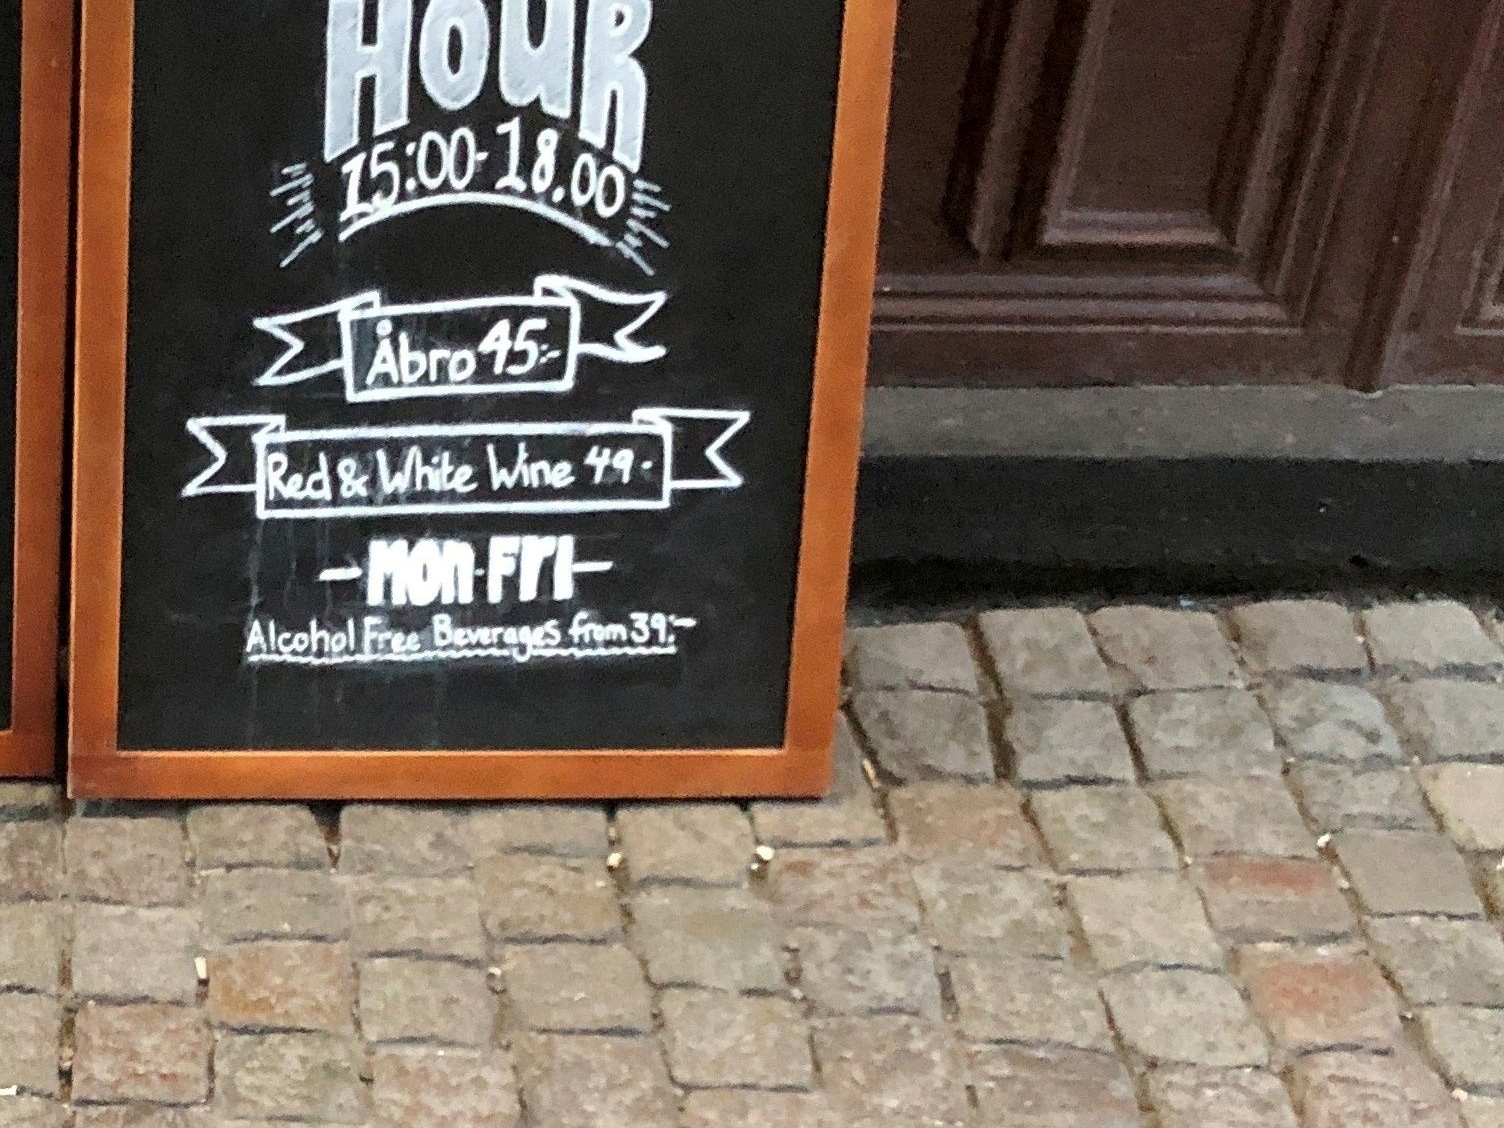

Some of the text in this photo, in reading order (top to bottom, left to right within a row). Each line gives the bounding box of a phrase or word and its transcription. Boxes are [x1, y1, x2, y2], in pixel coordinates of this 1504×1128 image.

[365, 319, 476, 385] Åbro
[267, 451, 332, 501] Red
[337, 457, 369, 499] &
[376, 445, 478, 495] White
[486, 442, 576, 492] Wine
[246, 617, 354, 654] Alcohol
[361, 615, 421, 656] Free
[431, 613, 562, 662] Beverages
[568, 610, 628, 644] from
